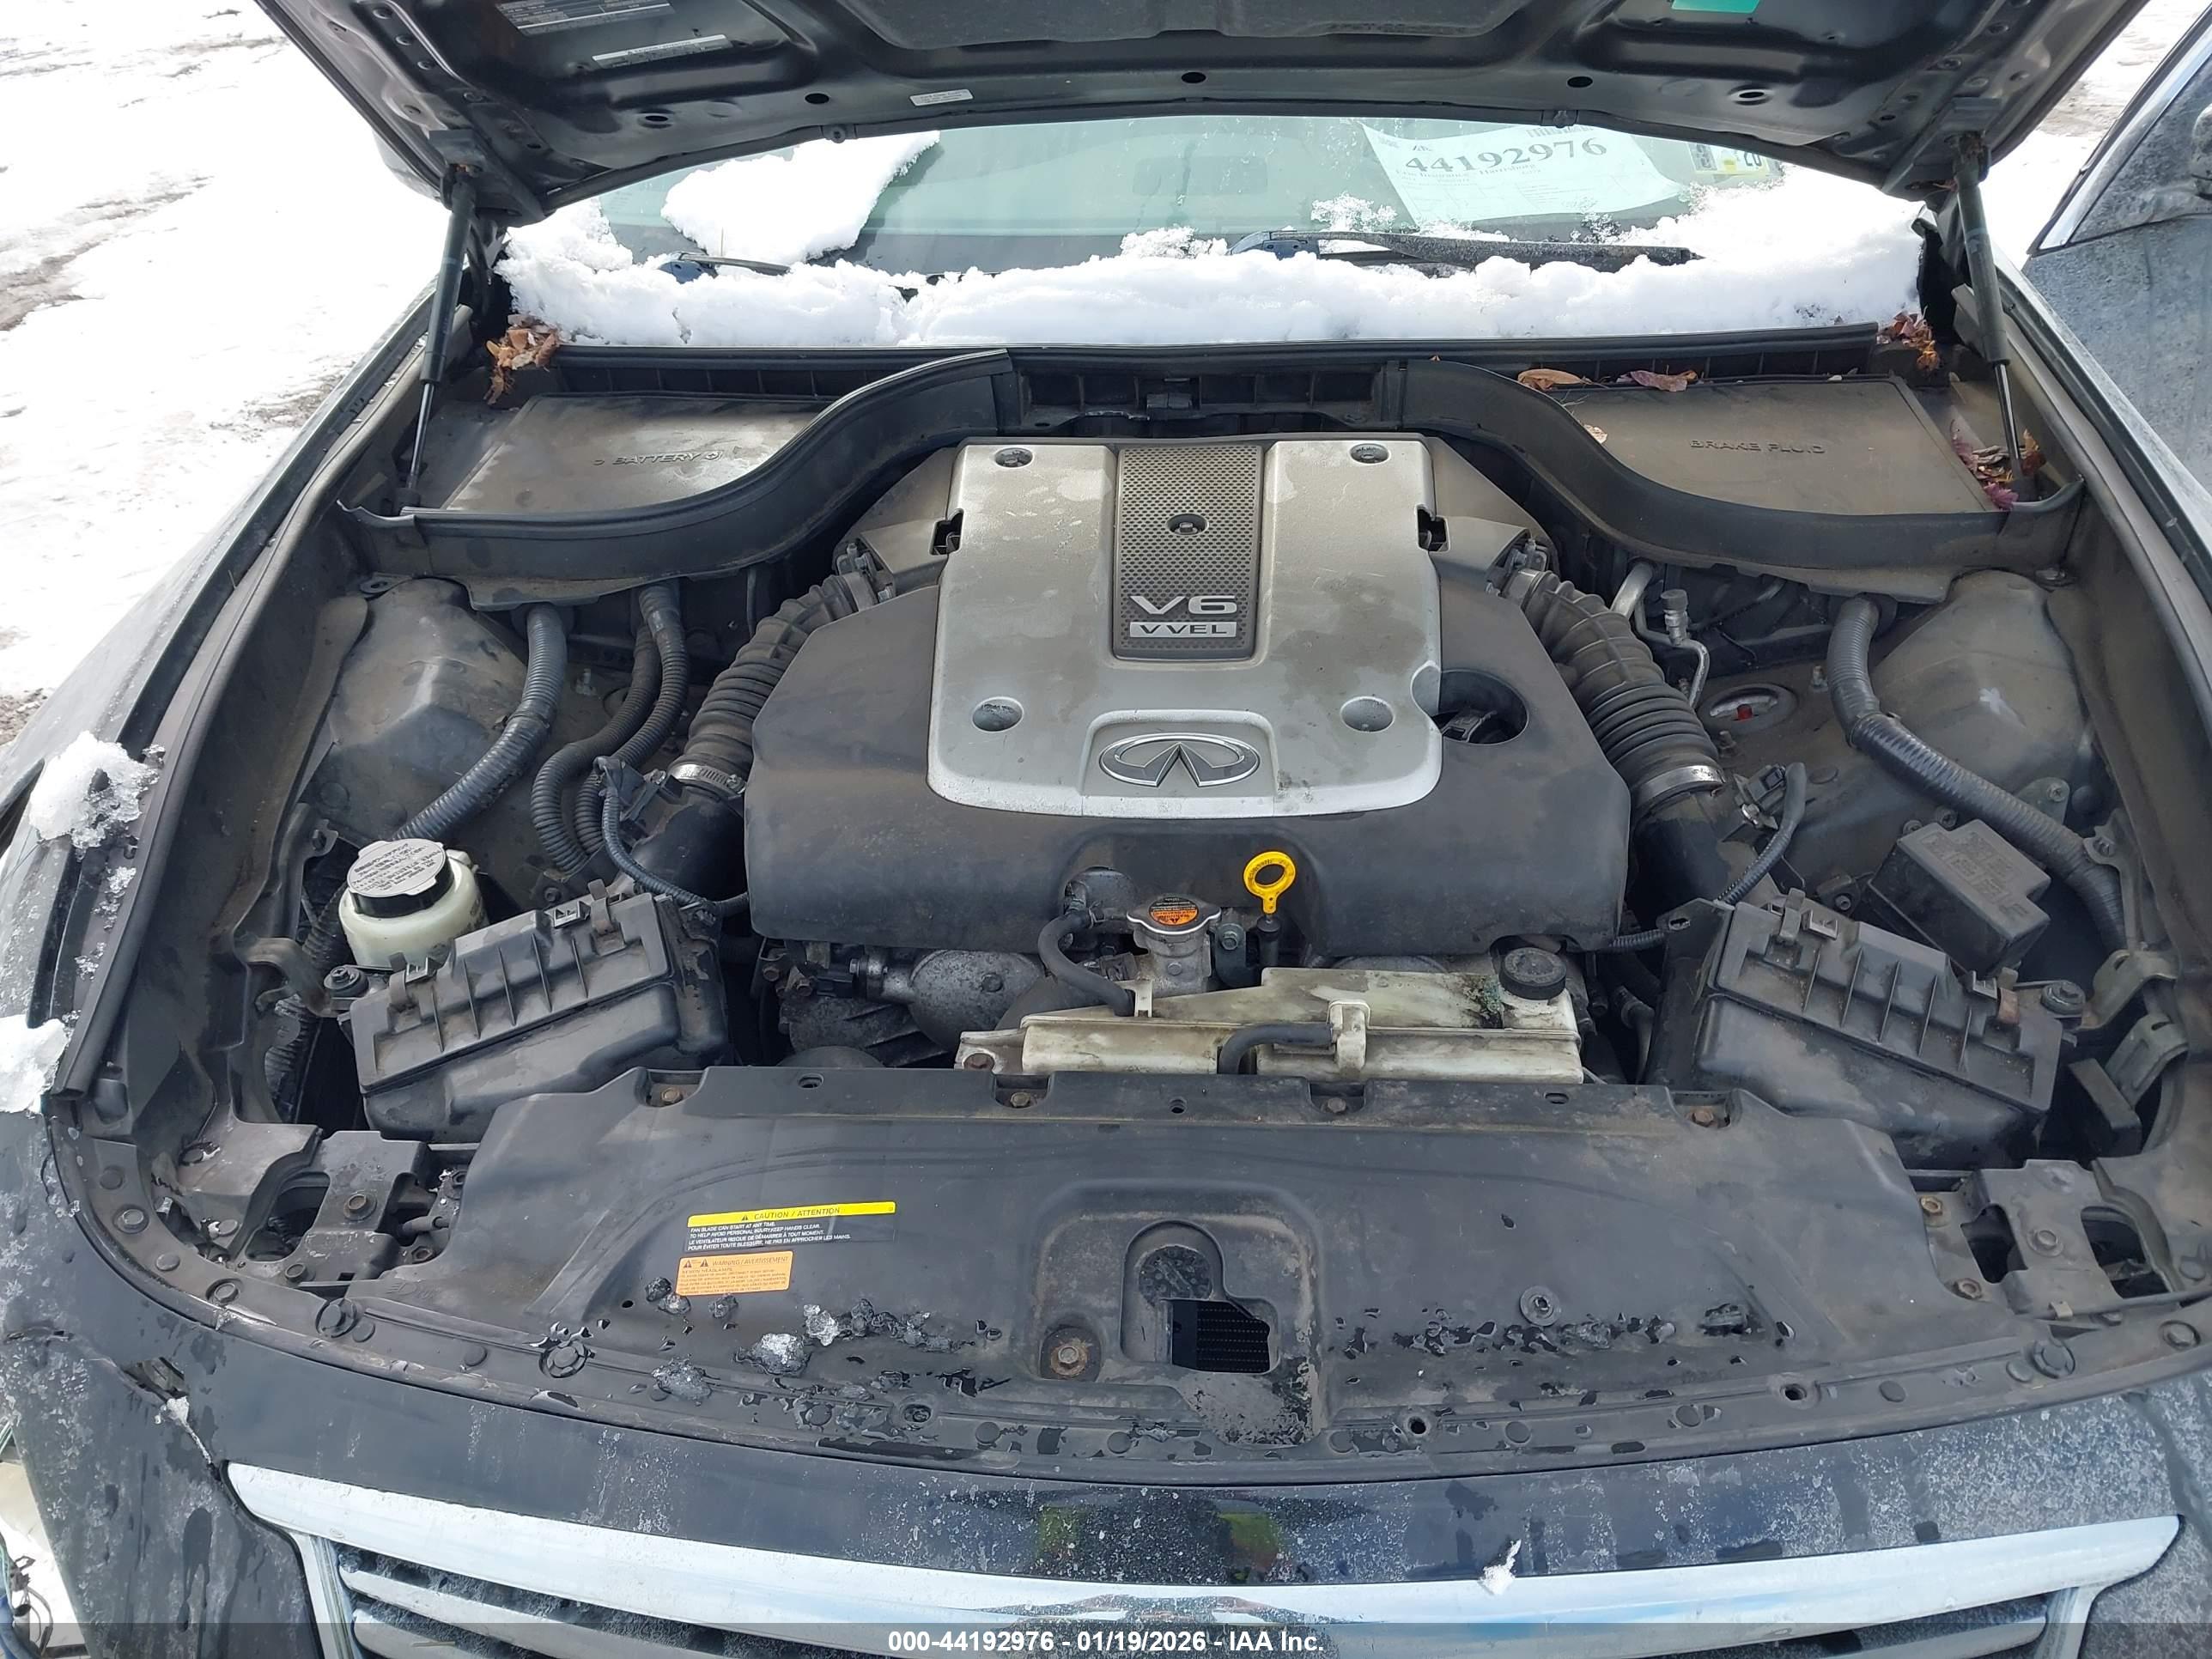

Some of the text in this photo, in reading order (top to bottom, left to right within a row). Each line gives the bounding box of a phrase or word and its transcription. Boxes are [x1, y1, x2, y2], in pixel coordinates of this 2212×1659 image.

[1406, 137, 1607, 173] 44192976
[1691, 440, 1826, 454] BRAKE FLUID
[612, 452, 702, 465] BATTERY
[1130, 595, 1237, 615] V6
[1139, 624, 1228, 635] VVEL
[797, 1208, 840, 1217] ATTENTION
